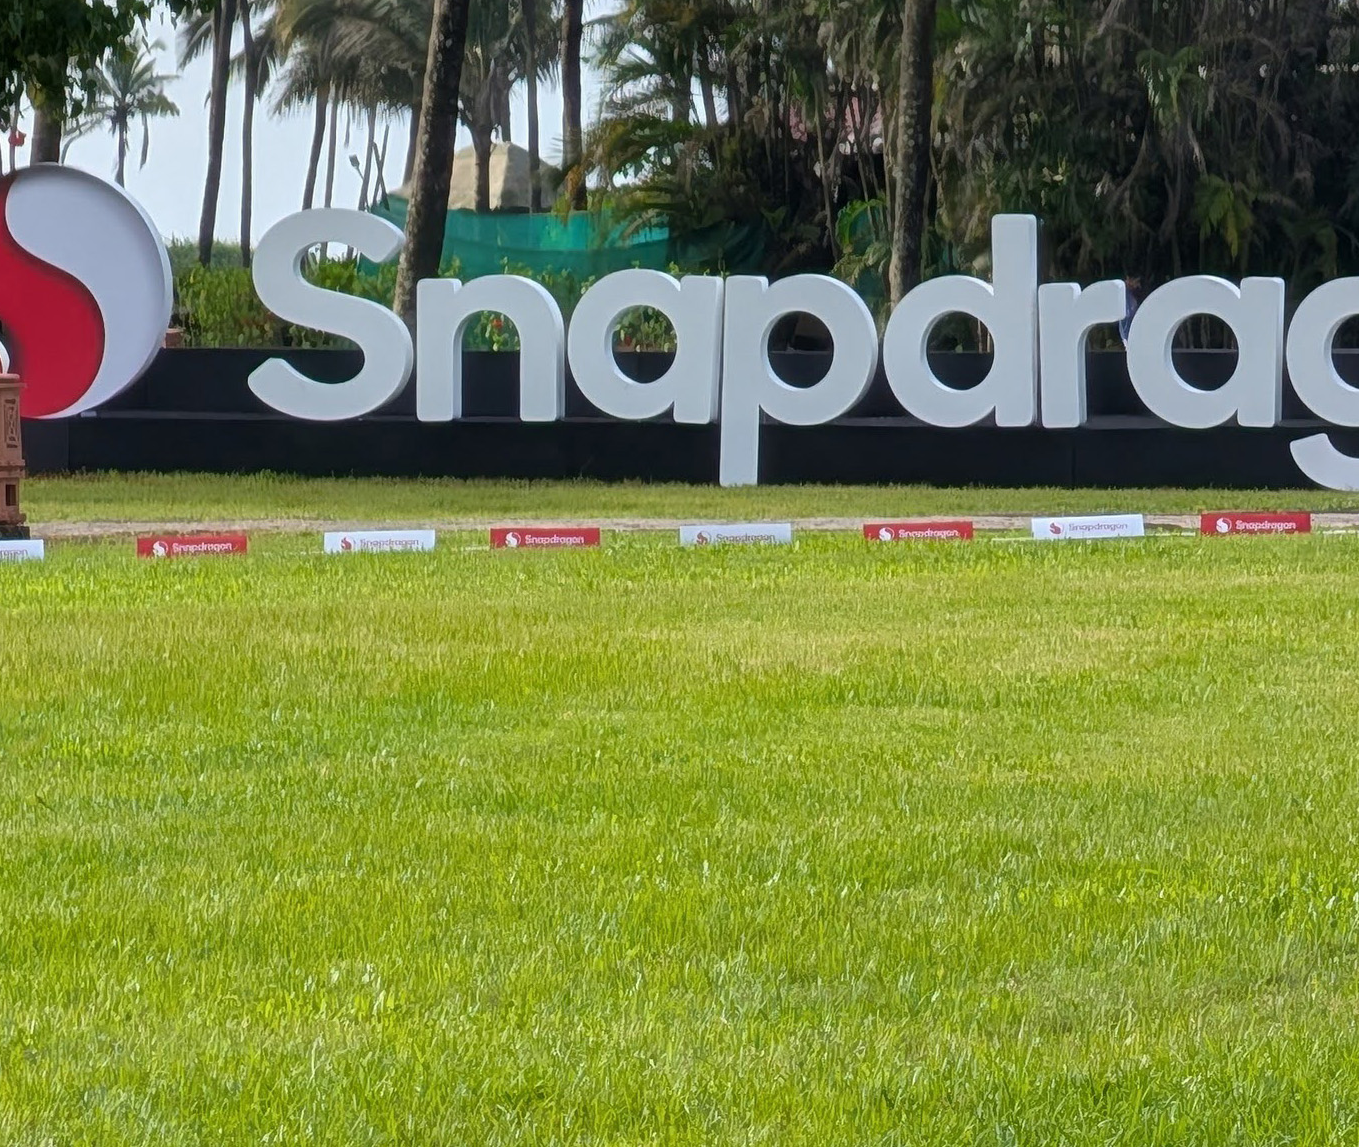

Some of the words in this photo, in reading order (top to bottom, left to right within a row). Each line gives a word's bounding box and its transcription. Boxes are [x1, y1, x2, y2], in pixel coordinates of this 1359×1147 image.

[1068, 522, 1128, 532] Snapdragon
[1234, 518, 1297, 531] Snapdragon
[359, 538, 419, 549] Snapdragon
[524, 533, 584, 545] Snapdragon
[172, 542, 232, 554] Snapdragon
